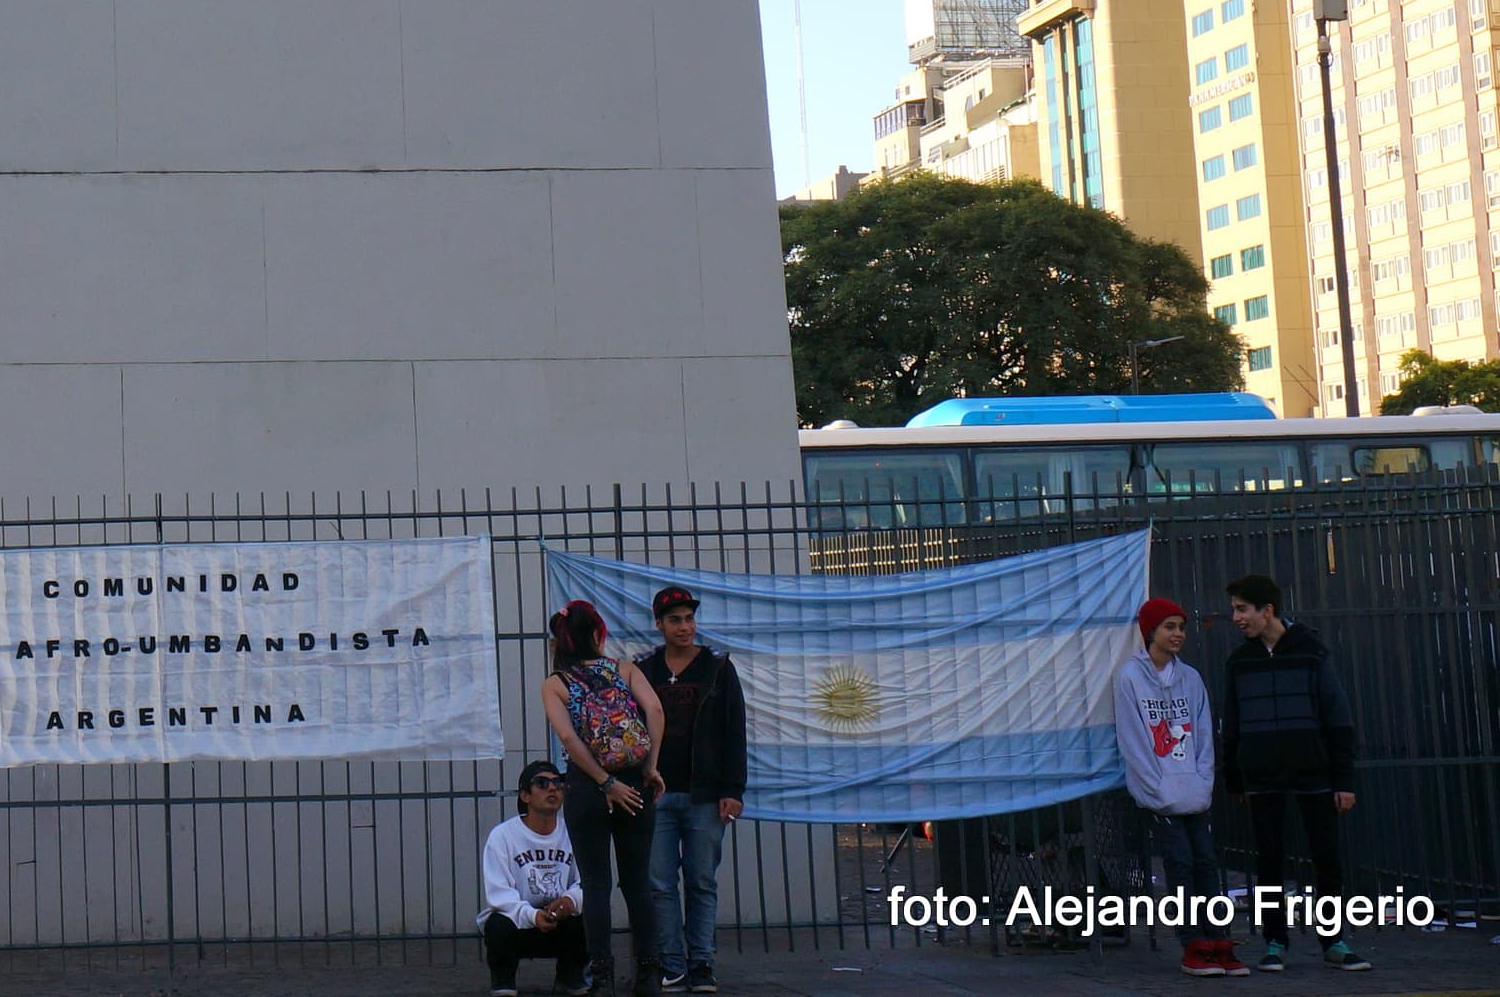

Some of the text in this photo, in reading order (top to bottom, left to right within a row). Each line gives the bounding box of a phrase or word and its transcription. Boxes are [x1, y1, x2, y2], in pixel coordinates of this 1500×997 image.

[43, 572, 300, 599] COMUNIDAD
[16, 627, 430, 660] AFRO-UMBANDISTA
[46, 704, 306, 731] ARGENTINA
